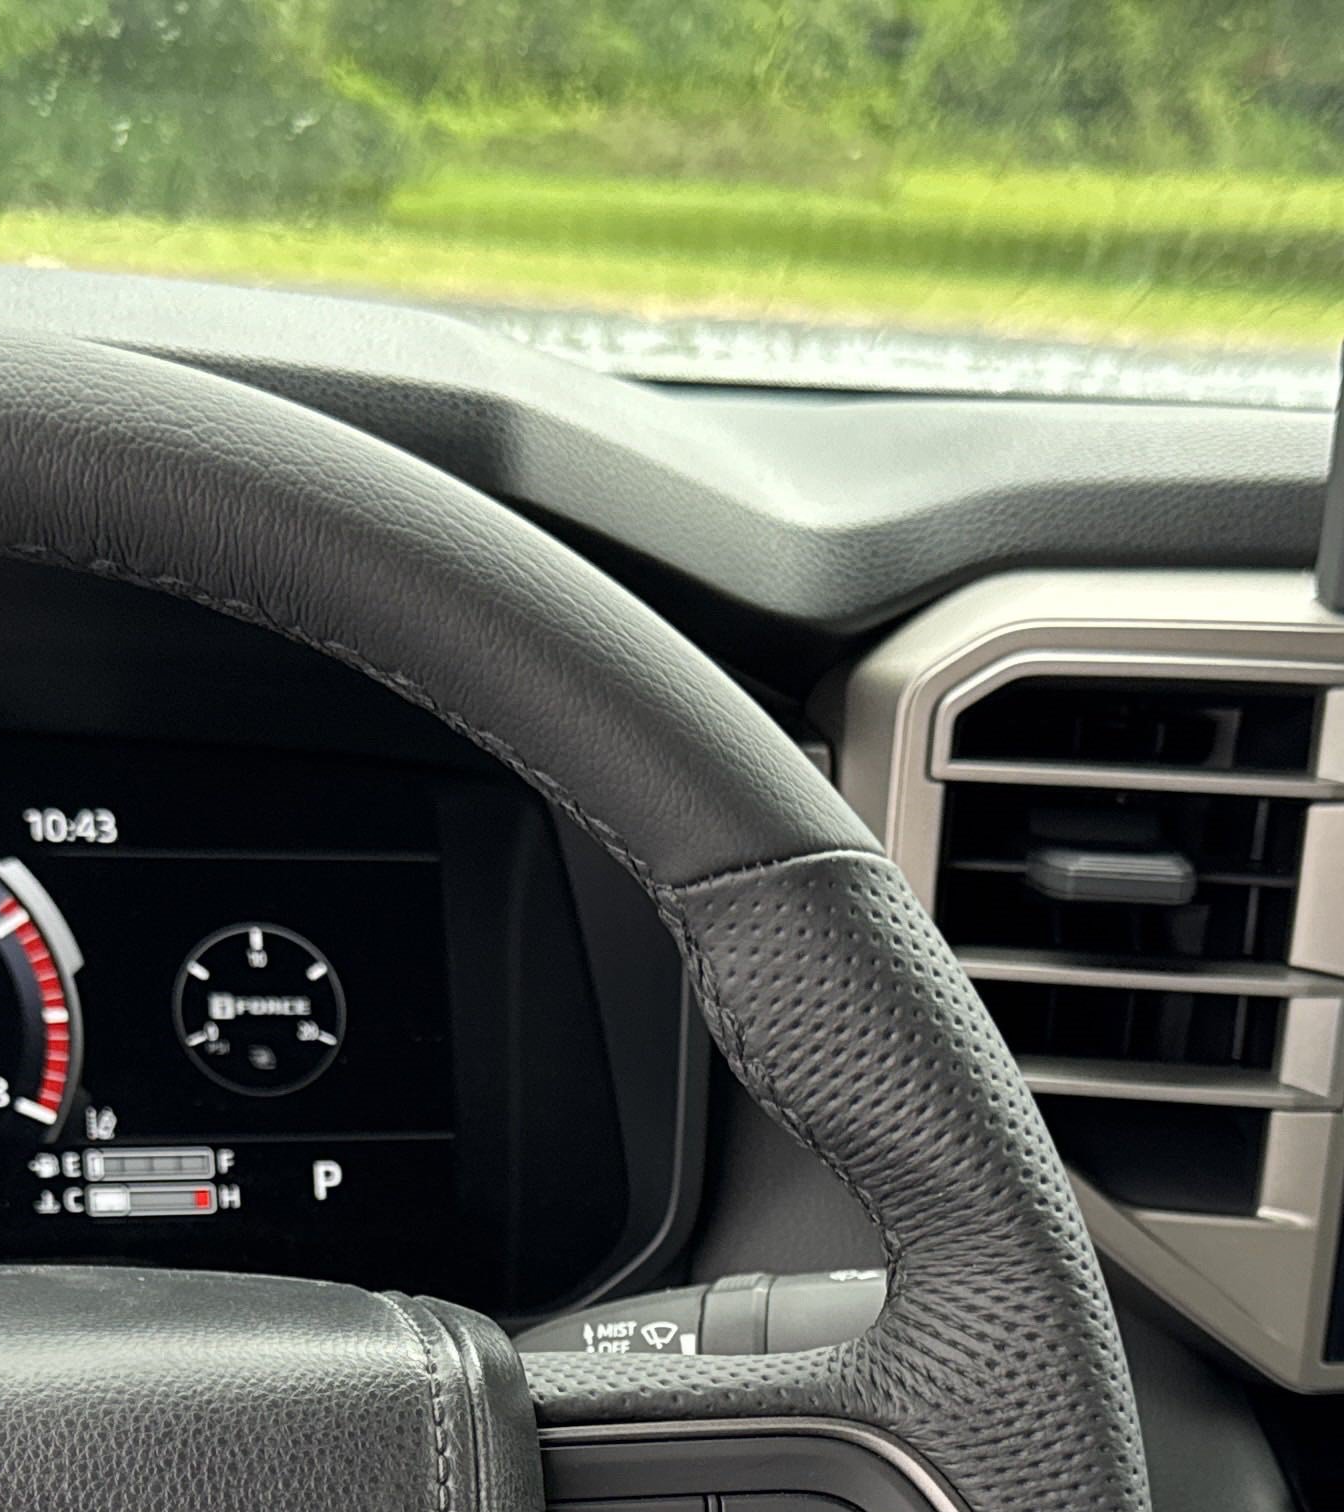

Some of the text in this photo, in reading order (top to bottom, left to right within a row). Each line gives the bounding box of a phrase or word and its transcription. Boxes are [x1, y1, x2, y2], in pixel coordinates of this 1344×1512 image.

[23, 808, 119, 843] 10:43
[62, 1148, 236, 1179] E F
[313, 1159, 343, 1201] P
[63, 1183, 242, 1214] C H
[596, 1320, 638, 1339] MIST
[598, 1339, 632, 1353] OFF
